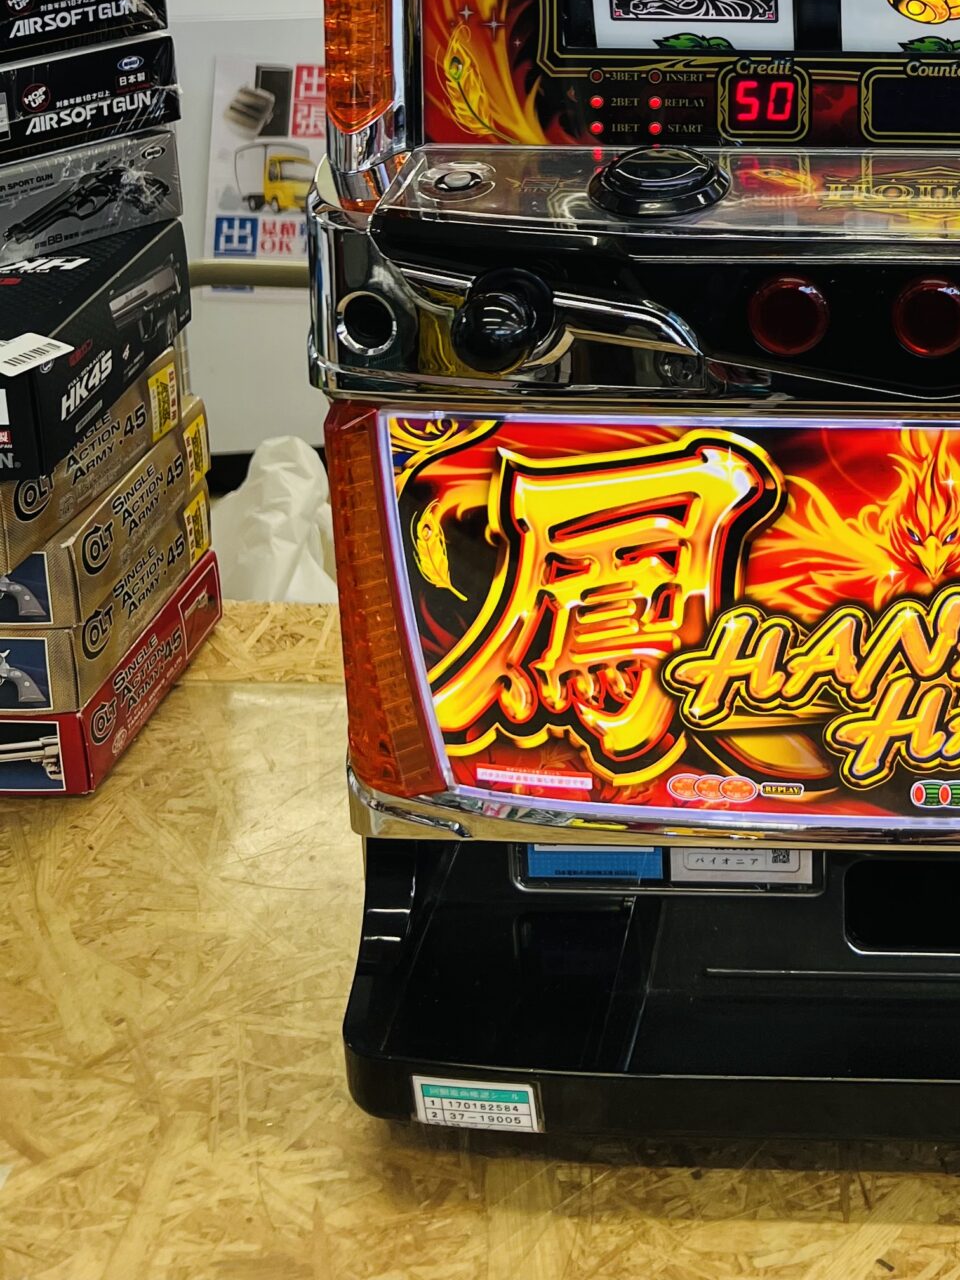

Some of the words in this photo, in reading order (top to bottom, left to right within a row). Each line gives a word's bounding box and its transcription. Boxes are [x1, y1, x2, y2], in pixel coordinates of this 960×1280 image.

[610, 71, 641, 81] 3BET
[665, 72, 704, 82] INSERT
[736, 59, 793, 76] Credit
[24, 86, 47, 104] HOP
[31, 94, 46, 108] UP
[610, 97, 641, 107] 2BET
[664, 98, 706, 108] REPLAY
[735, 79, 795, 121] 50
[610, 123, 641, 133] 1BET
[667, 123, 704, 133] START
[7, 177, 34, 192] SPORT
[36, 173, 53, 185] GUN
[259, 238, 293, 255] OK
[61, 350, 113, 421] HK45
[65, 420, 121, 473] ACTION
[72, 443, 116, 485] ARMY
[112, 464, 155, 517] SINGLE
[122, 472, 164, 527] ACTION
[128, 494, 161, 537] ARMY
[81, 519, 115, 576] COLT
[112, 545, 156, 600] SINGLE
[121, 554, 165, 610] ACTION
[127, 574, 162, 620] ARMY
[81, 602, 115, 660] COLT
[112, 633, 158, 693] SINGLE
[120, 646, 165, 708] ACTION
[126, 671, 161, 717] ARMY
[90, 696, 118, 745] COLT
[764, 784, 801, 795] REPLAY
[695, 857, 759, 866] パイオニア
[448, 1101, 519, 1113] 170182584
